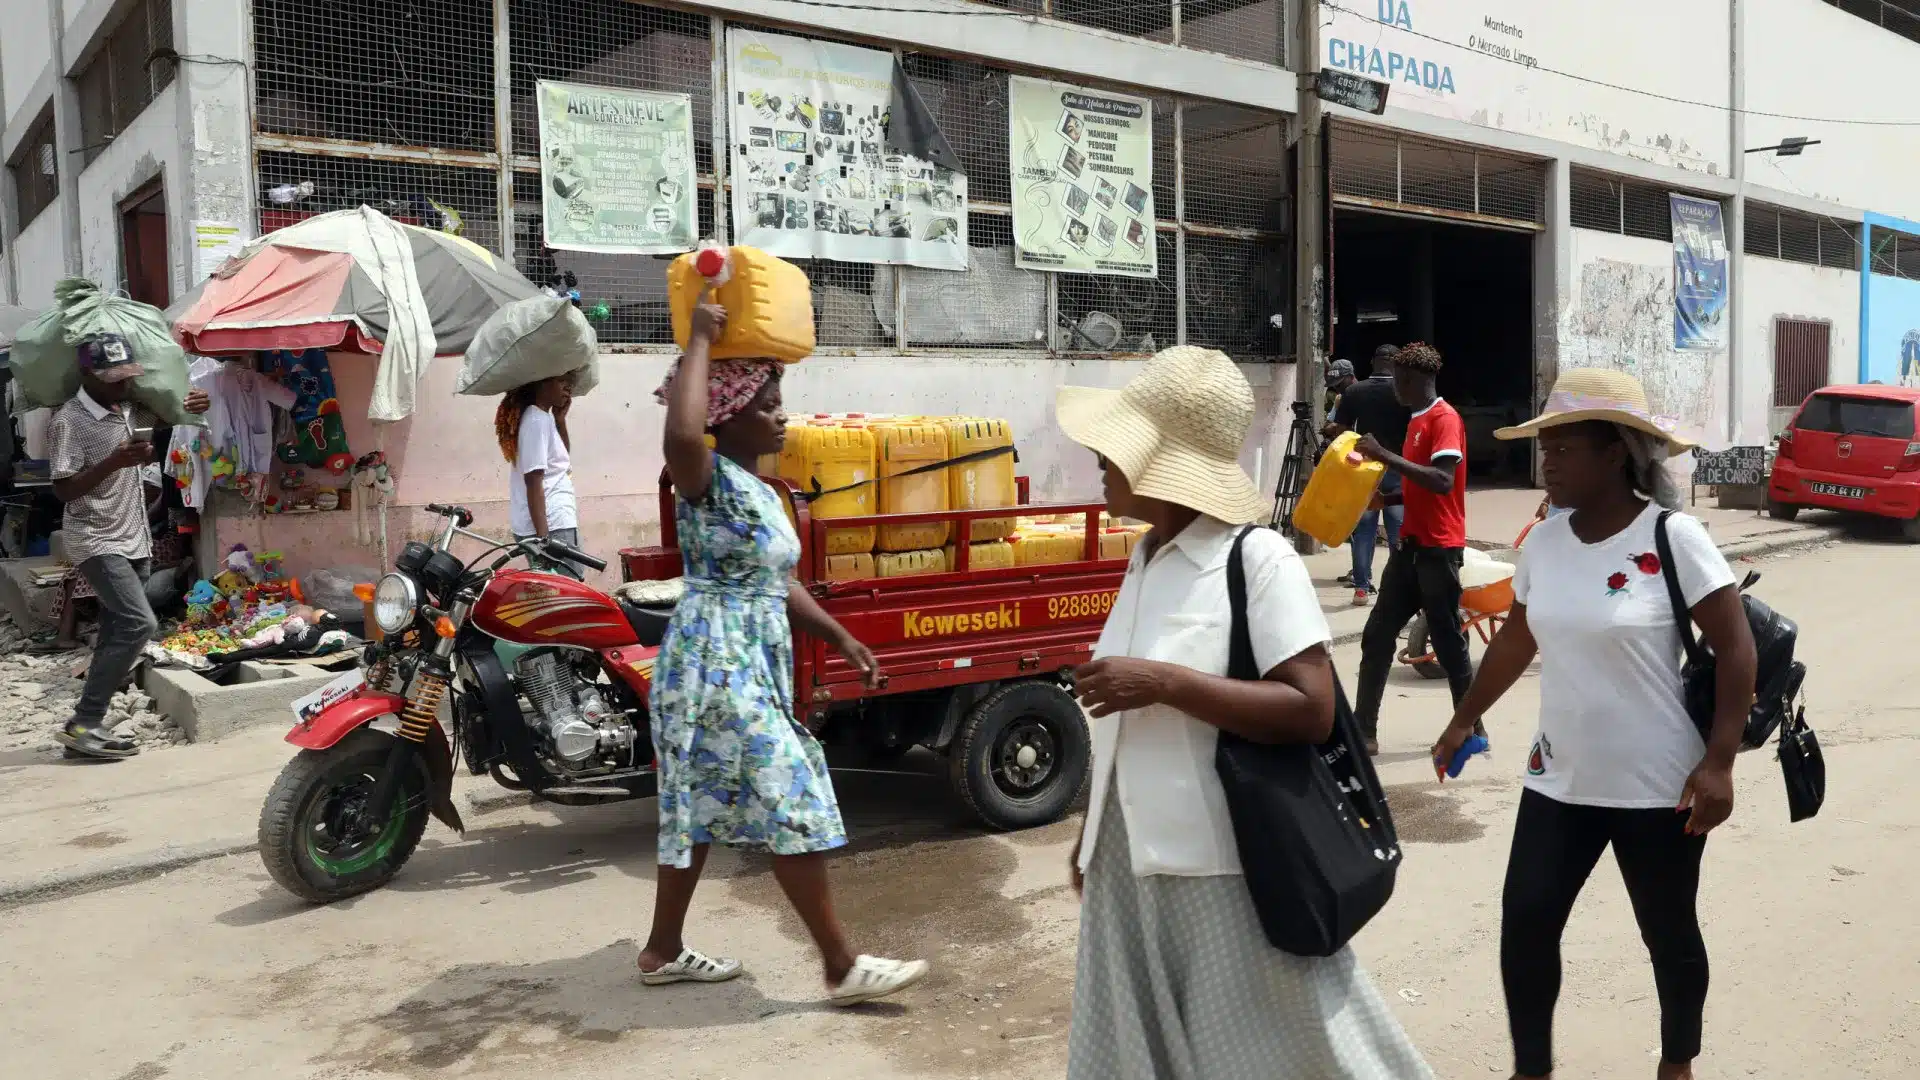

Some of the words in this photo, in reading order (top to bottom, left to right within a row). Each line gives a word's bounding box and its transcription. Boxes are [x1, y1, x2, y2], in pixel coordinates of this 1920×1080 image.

[1377, 0, 1413, 30] DA
[1484, 15, 1523, 39] Mantenha
[1468, 35, 1477, 48] O
[1478, 37, 1511, 58] Mercado
[1513, 48, 1538, 69] Limpo
[1329, 38, 1456, 94] CHAPADA
[594, 113, 644, 126] COMERCIAL
[1083, 114, 1104, 125] NOSSOS
[1719, 458, 1732, 468] DE
[1708, 468, 1722, 484] DE
[1725, 469, 1760, 485] CARRO
[1826, 485, 1837, 495] 29
[903, 601, 1021, 639] Keweseki
